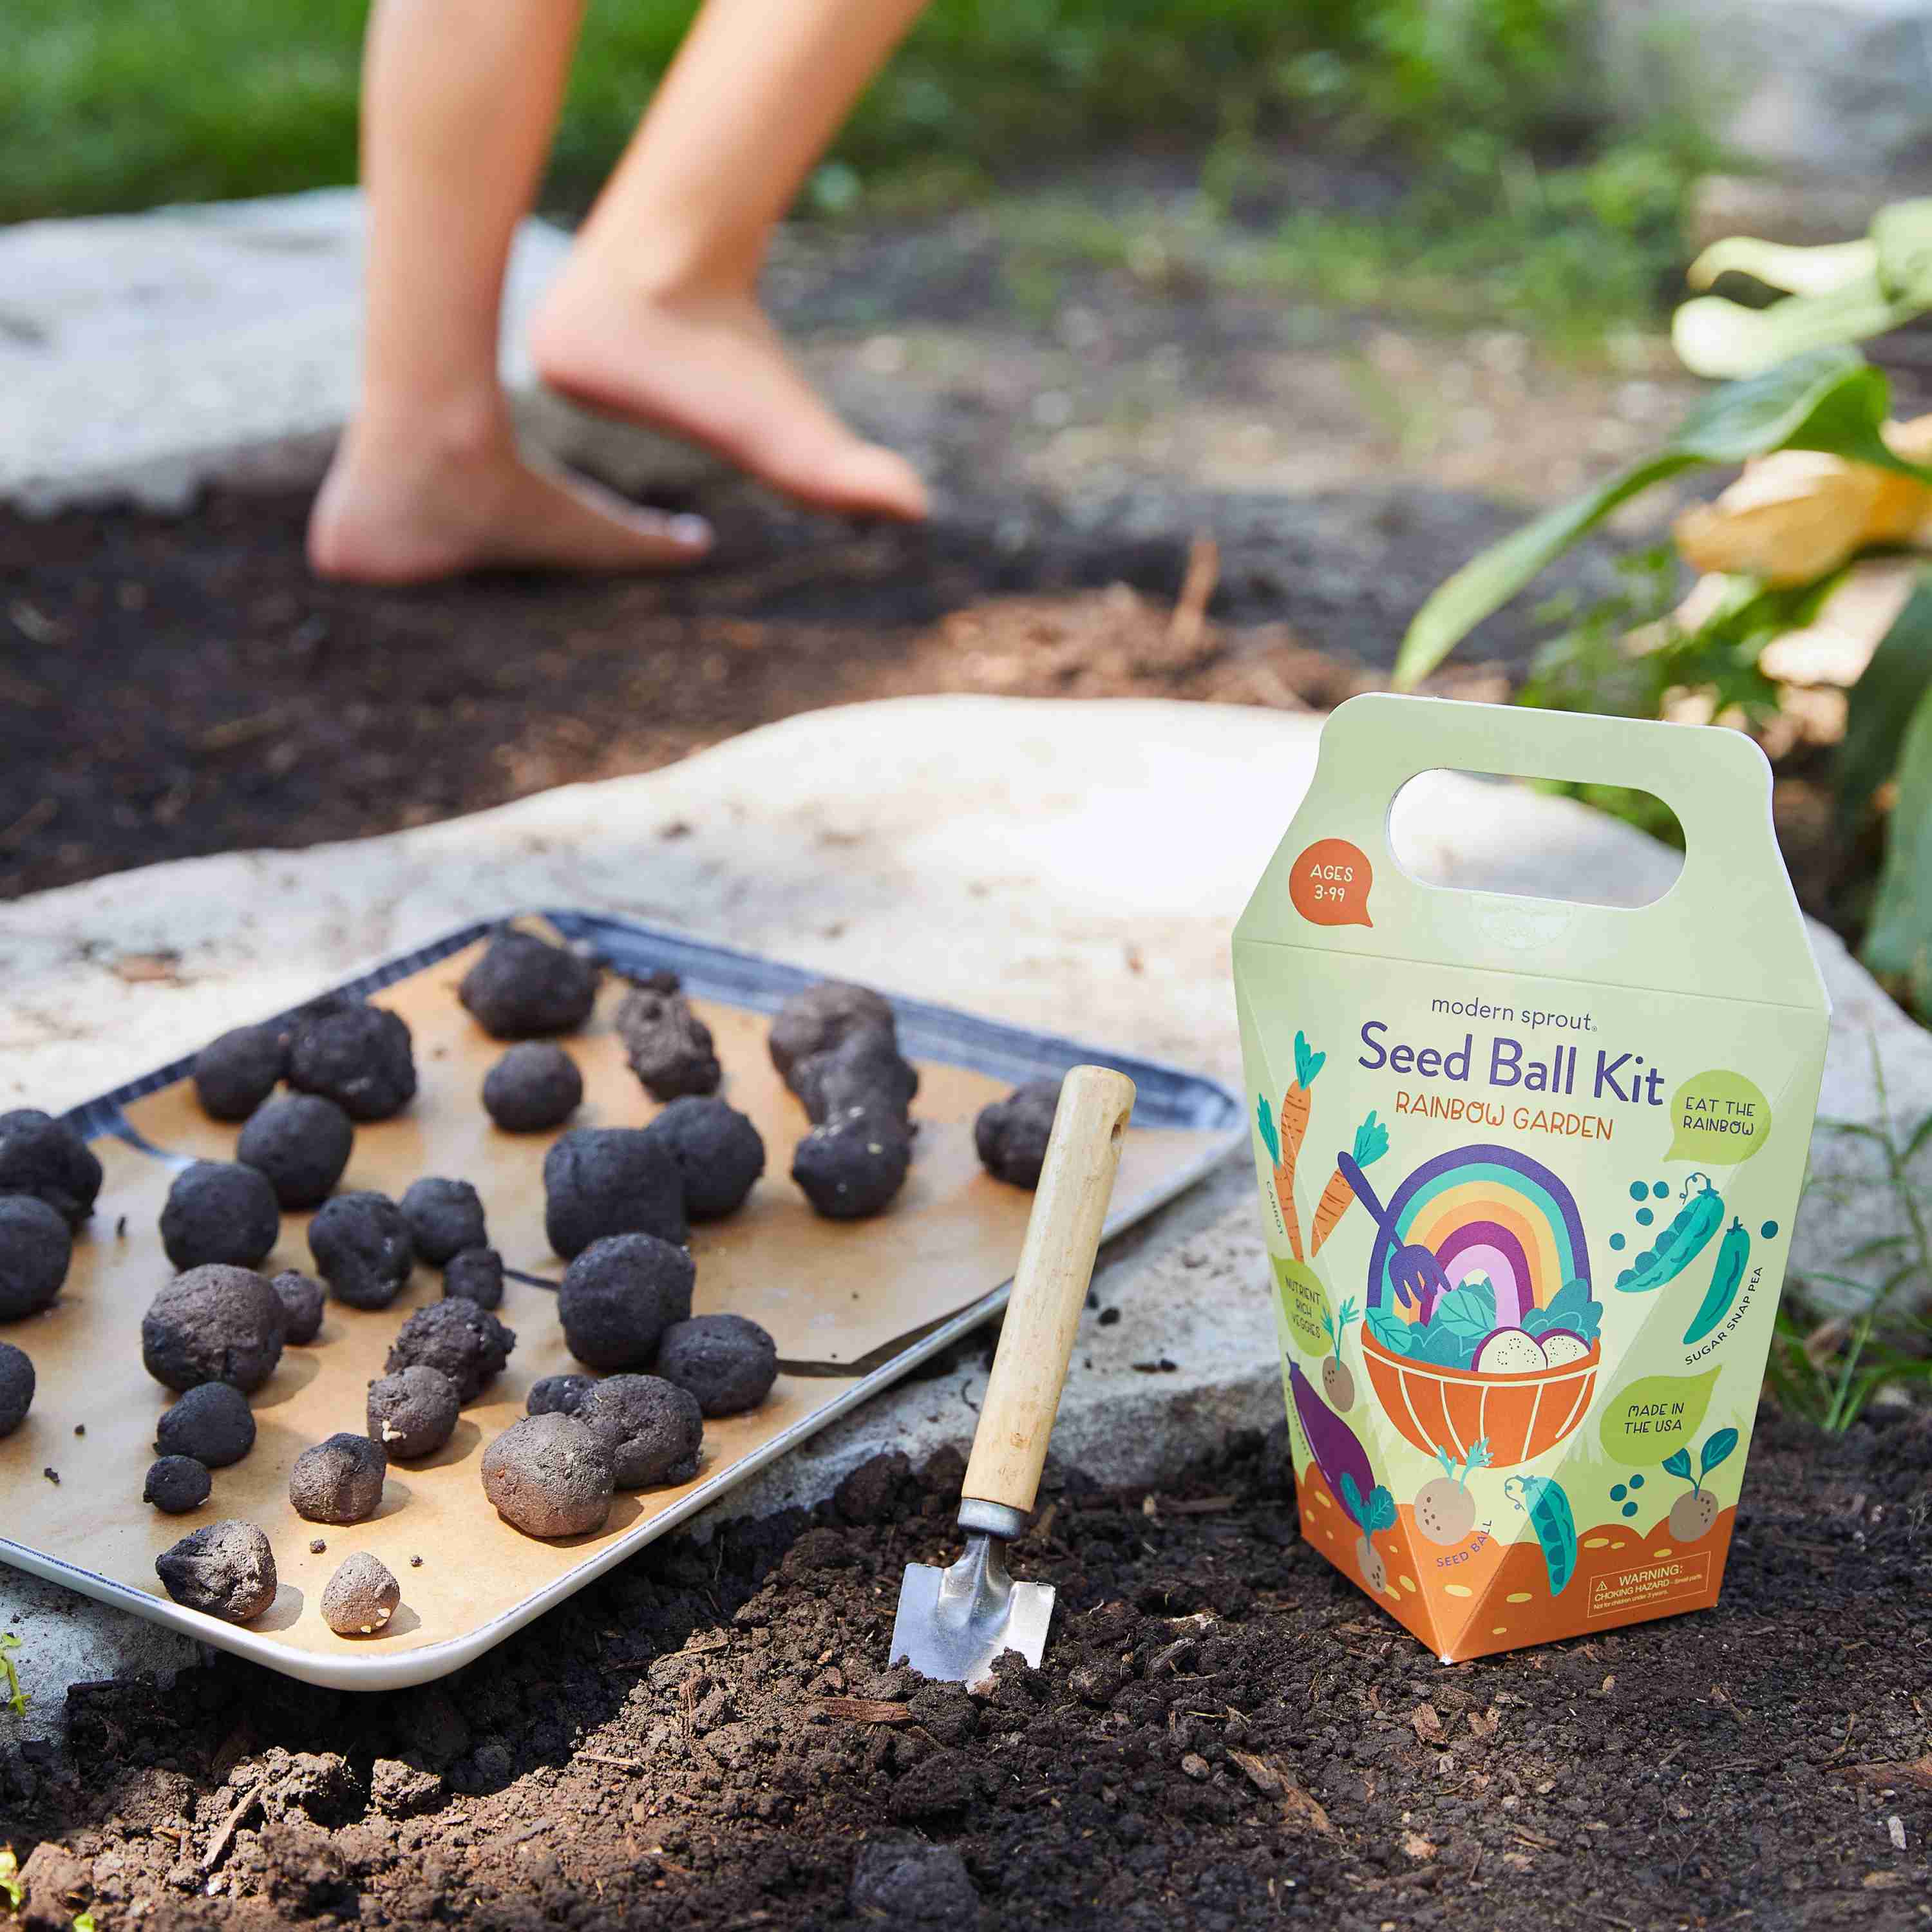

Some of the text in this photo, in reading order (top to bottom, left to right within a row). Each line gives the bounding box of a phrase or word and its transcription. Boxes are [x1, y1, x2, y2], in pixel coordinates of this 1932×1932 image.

[1310, 864, 1354, 882] AGES
[1314, 884, 1345, 902] 3-99
[1432, 997, 1513, 1021] modern
[1358, 1021, 1665, 1106] Seed Ball Kit
[1396, 1091, 1613, 1141] RAINBOW GARDEN
[1686, 1097, 1756, 1116] EAT THE
[1683, 1115, 1754, 1135] RAINBOW
[1685, 1267, 1763, 1365] SUGAR SNAP PEA
[1628, 1402, 1685, 1417] MADE IN
[1624, 1419, 1682, 1434] THE USA
[1437, 1520, 1492, 1567] SEED BALL
[1619, 1564, 1683, 1586] WARNING:
[1595, 1586, 1634, 1602] CHOKING
